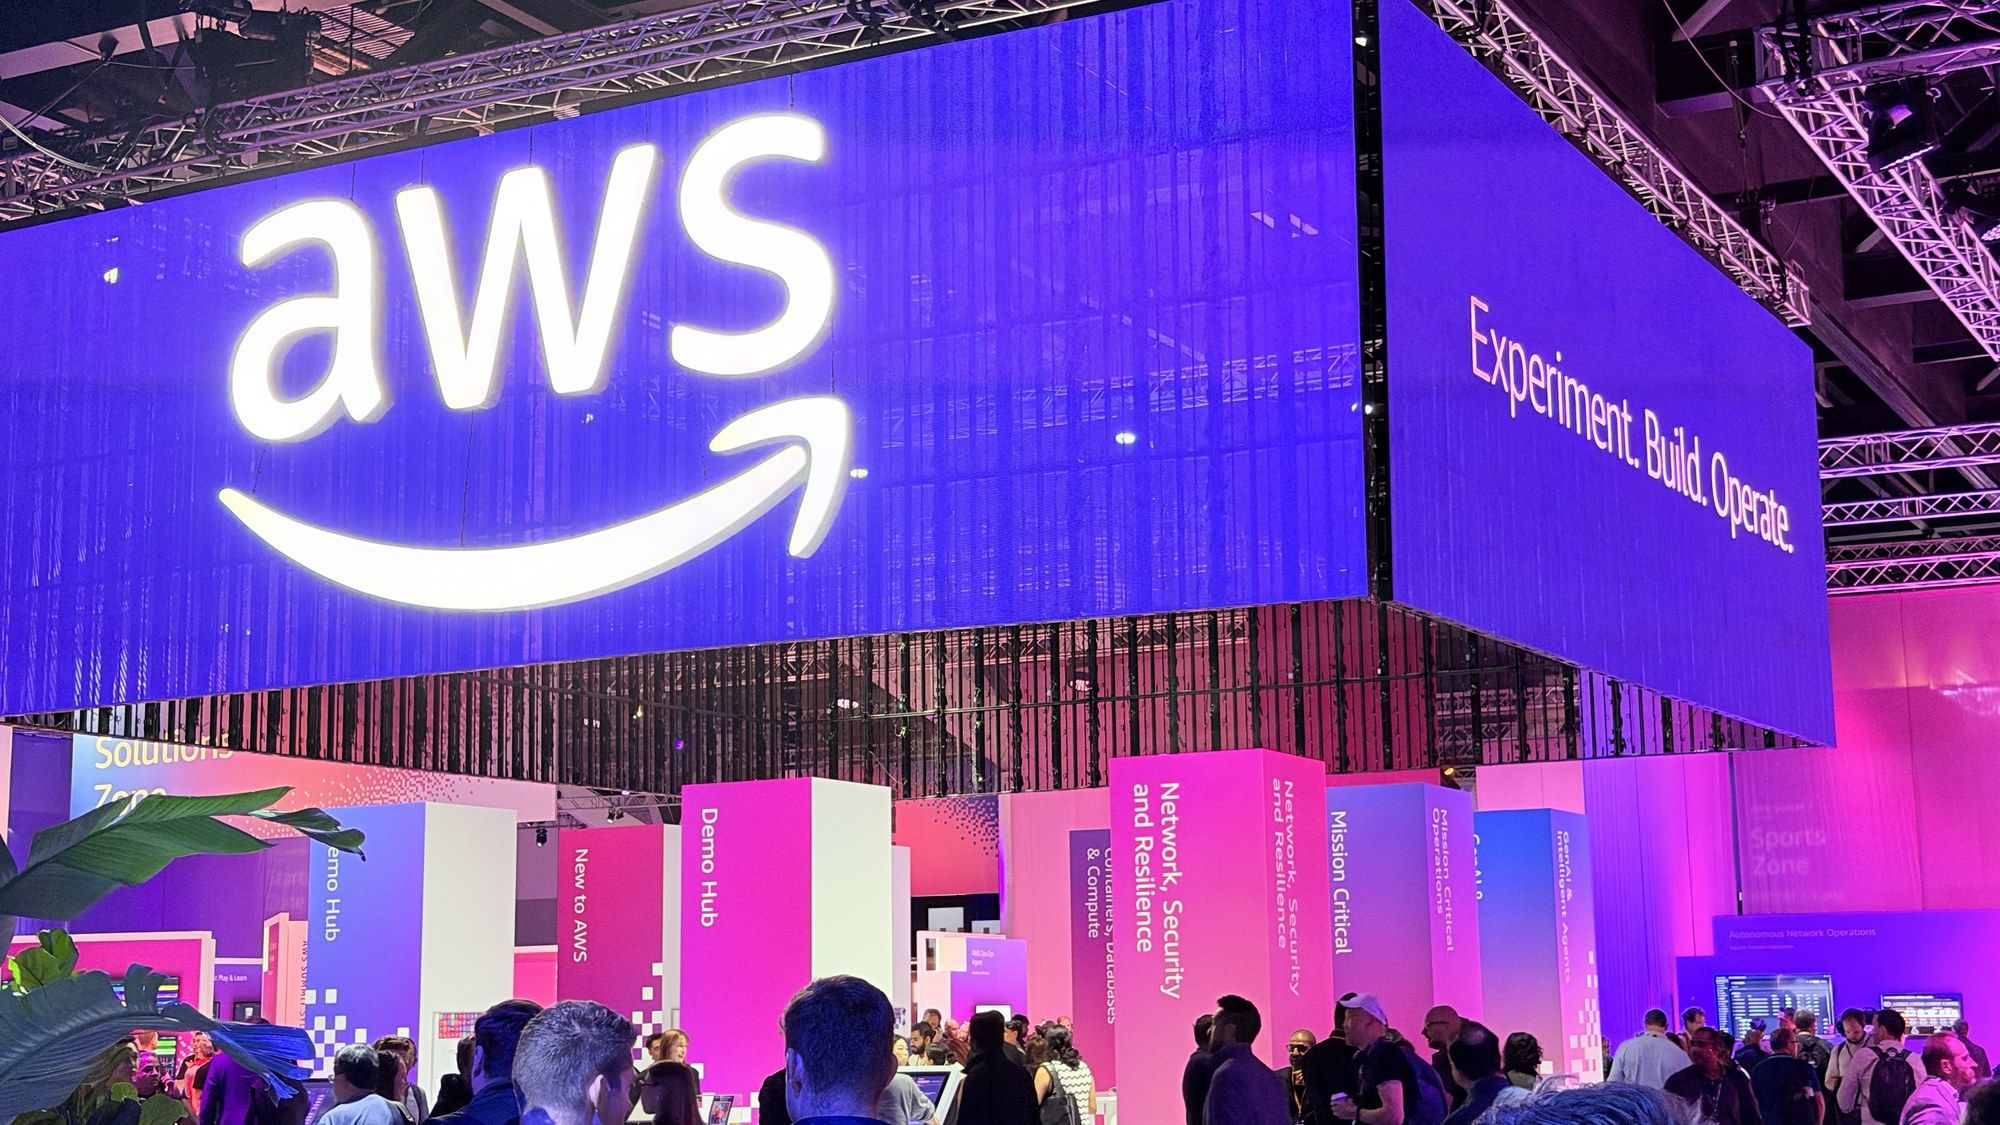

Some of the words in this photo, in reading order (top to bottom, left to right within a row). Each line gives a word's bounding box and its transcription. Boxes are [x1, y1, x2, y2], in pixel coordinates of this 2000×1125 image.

[230, 115, 835, 442] aws
[1470, 295, 1639, 469] Experiment.
[1645, 408, 1708, 507] Build.
[1711, 451, 1794, 554] Operate.
[1133, 784, 1154, 827] and
[1273, 778, 1284, 823] and
[701, 808, 718, 873] Demo
[1087, 848, 1100, 861] &
[1159, 782, 1183, 892] Network,
[1284, 781, 1297, 889] Network,
[1331, 811, 1348, 882] Mission
[1432, 808, 1443, 914] Operations
[1440, 809, 1449, 879] Mission
[1750, 826, 1827, 852] Sports
[1751, 855, 1809, 876] Zone
[325, 846, 340, 892] emo
[574, 849, 589, 890] New
[1085, 866, 1100, 938] Compute
[1134, 836, 1156, 953] Resilience
[1275, 832, 1286, 949] Resilience
[1557, 831, 1567, 918] Intelligent
[325, 899, 341, 941] Hub
[573, 894, 587, 914] to
[701, 881, 718, 927] Hub
[1333, 888, 1353, 955] Critical
[1444, 886, 1454, 951] Critical
[1729, 930, 1784, 939] Autonomous
[1786, 929, 1824, 938] Network
[1826, 928, 1877, 938] Operations
[573, 919, 588, 962] AWS
[1160, 900, 1185, 999] Security
[1288, 899, 1300, 996] Security
